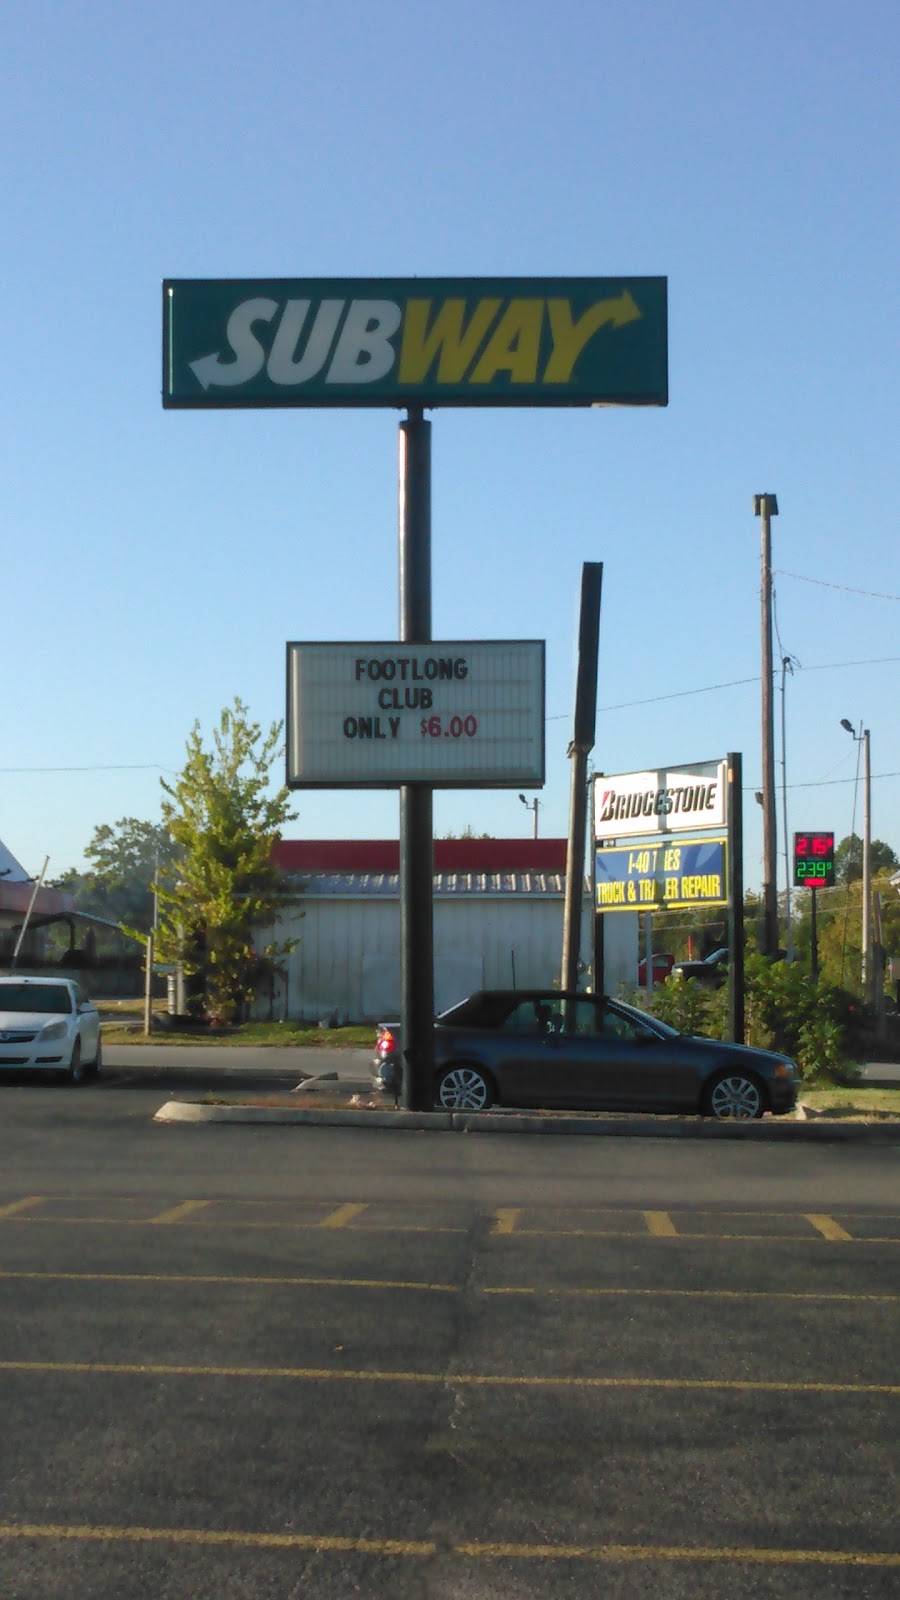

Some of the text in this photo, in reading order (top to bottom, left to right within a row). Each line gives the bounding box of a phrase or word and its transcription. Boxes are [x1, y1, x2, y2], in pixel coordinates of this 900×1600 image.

[188, 289, 642, 391] SUBWAY
[355, 658, 468, 681] FOOTLONG
[378, 687, 433, 709] CLUB
[343, 715, 478, 739] ONLY $6.00
[600, 783, 717, 822] BRIDGESTONE
[628, 851, 650, 874] I-40
[597, 881, 625, 904] TRUCK
[627, 880, 636, 902] &
[681, 875, 720, 898] REPAIR
